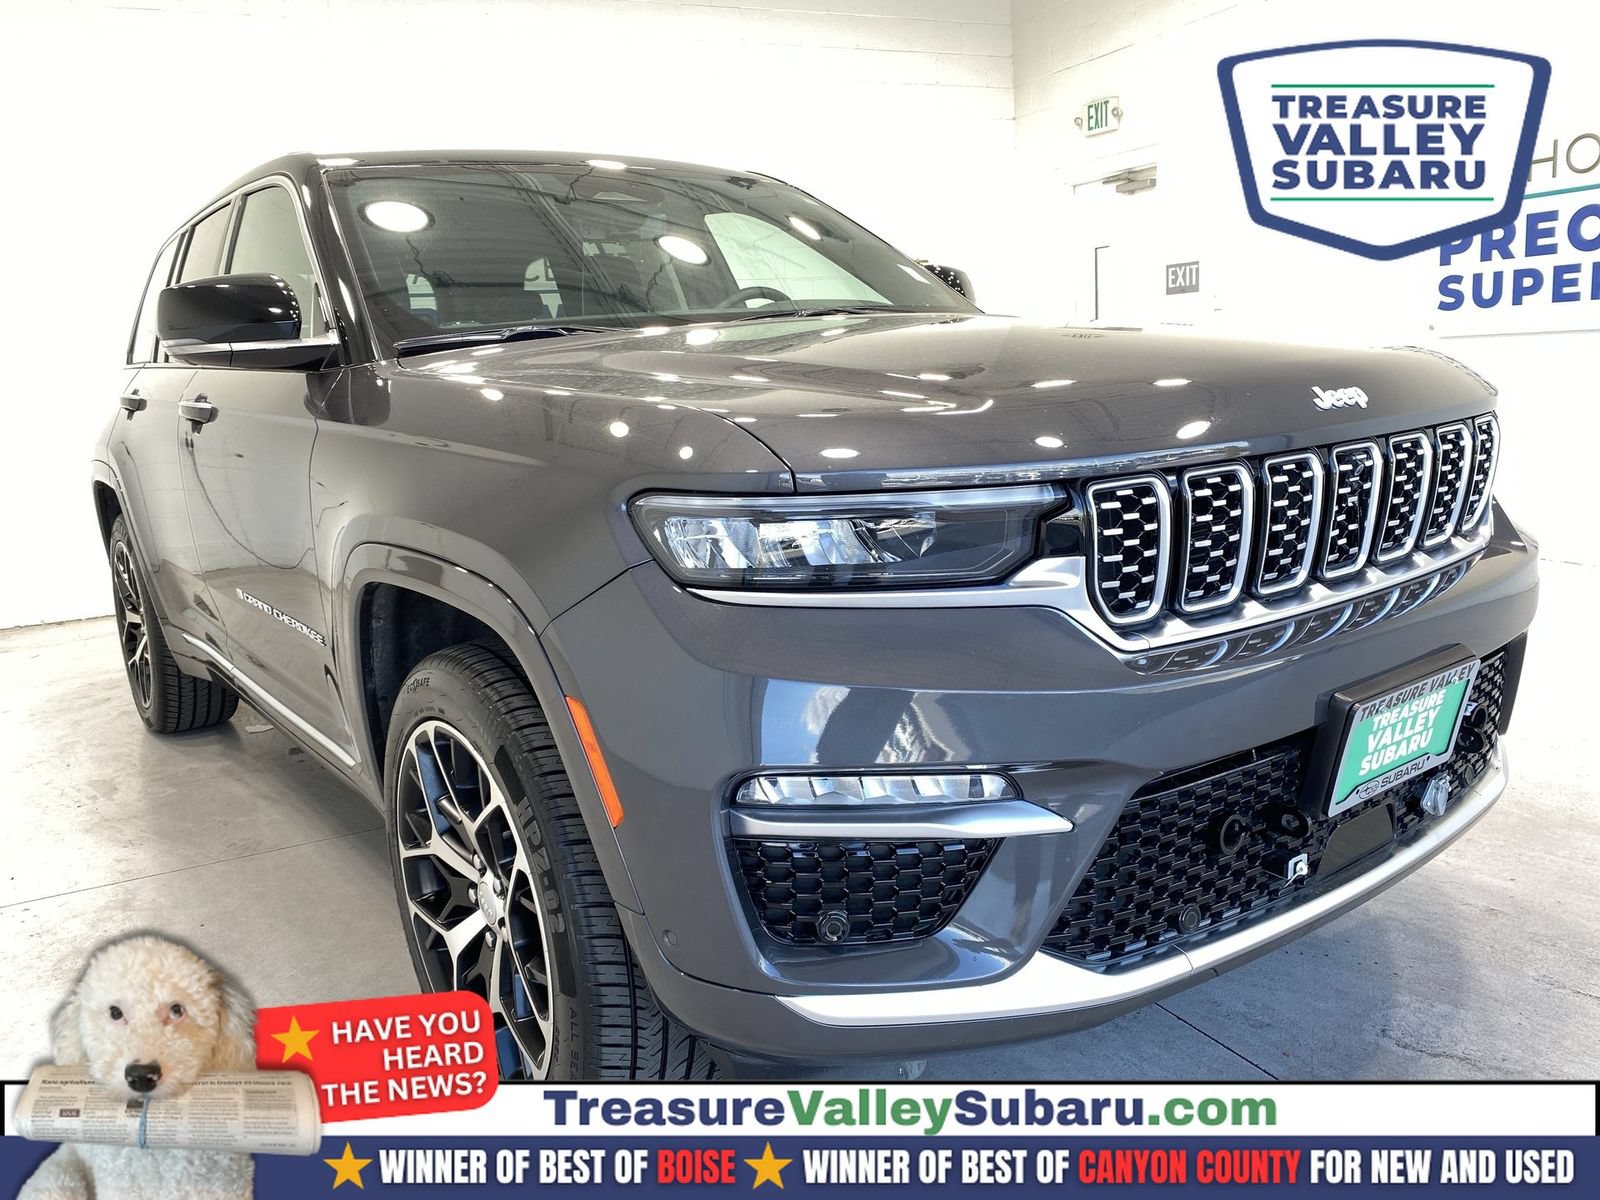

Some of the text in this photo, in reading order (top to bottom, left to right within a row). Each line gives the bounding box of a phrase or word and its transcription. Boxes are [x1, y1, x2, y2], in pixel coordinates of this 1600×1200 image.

[1088, 100, 1109, 131] EXIT
[1168, 264, 1199, 288] EXIT
[1311, 386, 1369, 410] Jeep
[1360, 663, 1475, 722] TREASURE VALLEY
[1372, 688, 1446, 731] TREASURE
[1367, 706, 1441, 753] VALLEY
[1358, 728, 1434, 777] SUBARU
[1380, 761, 1426, 788] SUBARU
